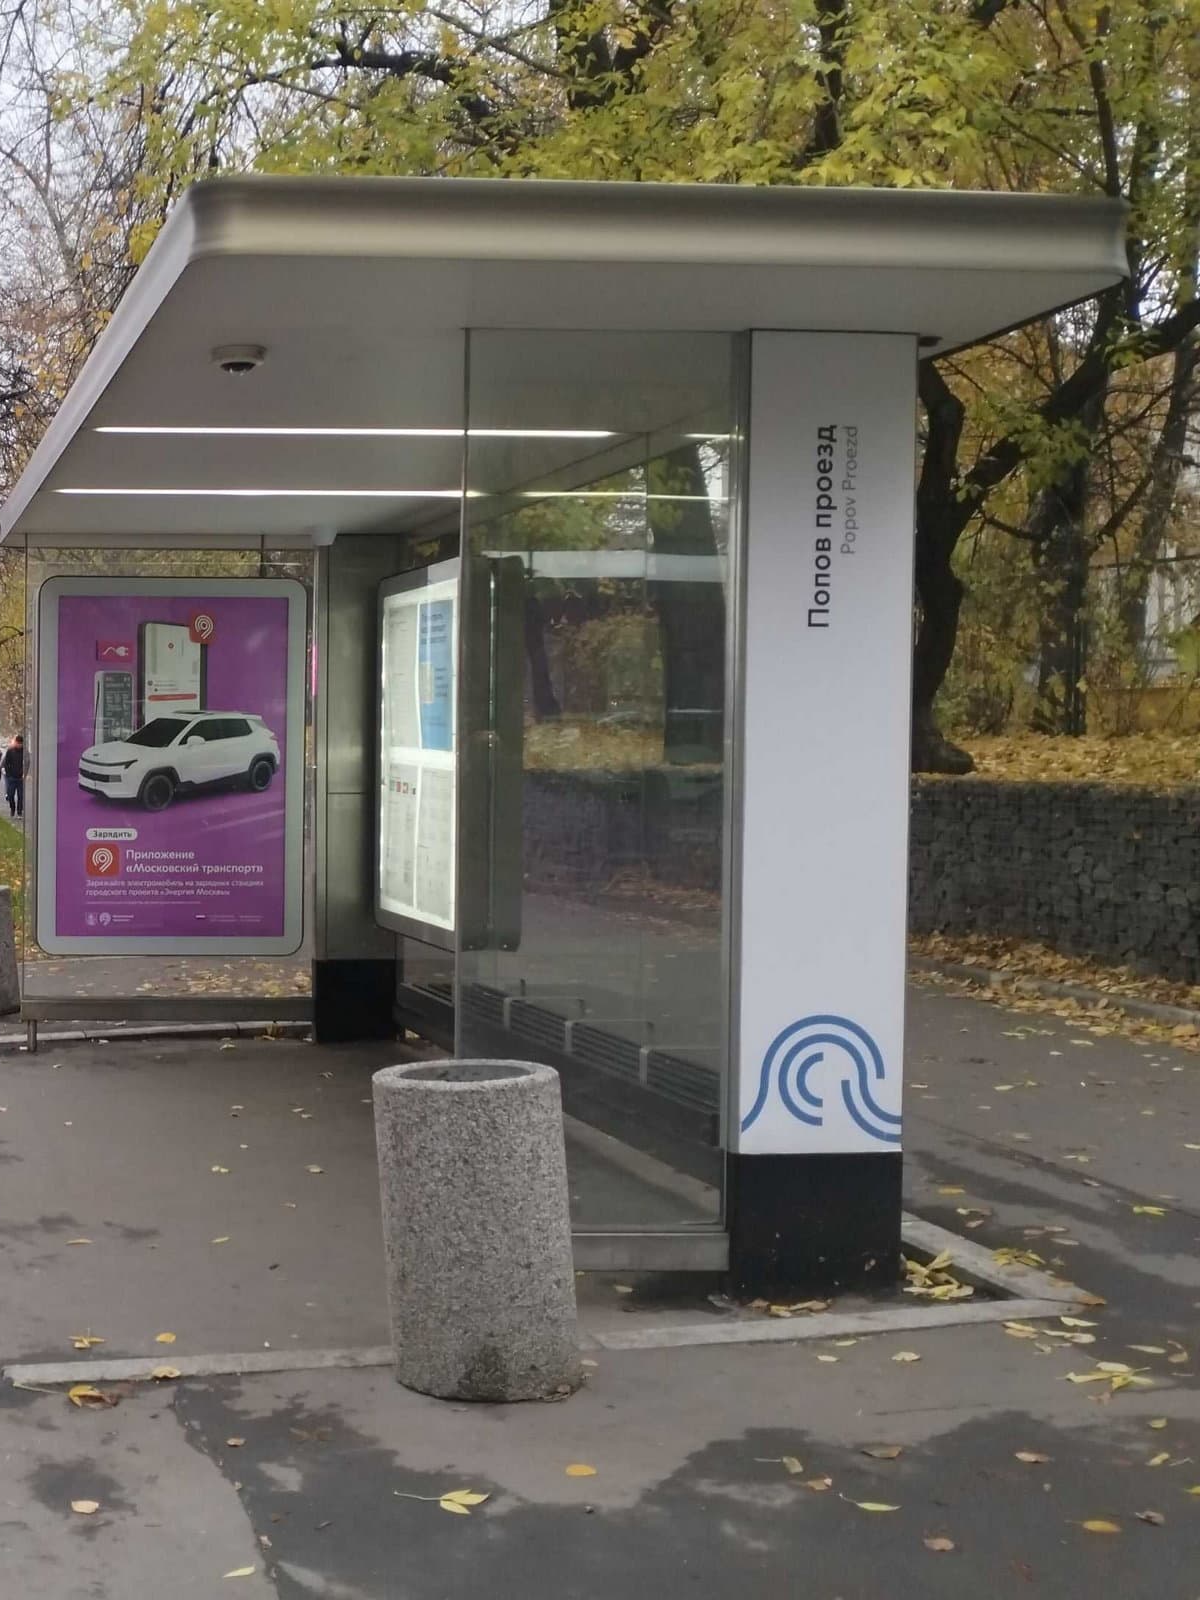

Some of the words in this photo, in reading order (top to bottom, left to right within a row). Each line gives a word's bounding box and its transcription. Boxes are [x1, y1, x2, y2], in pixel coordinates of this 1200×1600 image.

[815, 424, 838, 528] проезд
[841, 425, 859, 490] Proezd
[840, 496, 860, 555] Popov
[807, 537, 832, 628] Попов
[92, 829, 132, 839] Зарядить
[126, 849, 195, 860] Приложение
[126, 862, 199, 873] «Московский
[200, 864, 264, 875] транспорт»
